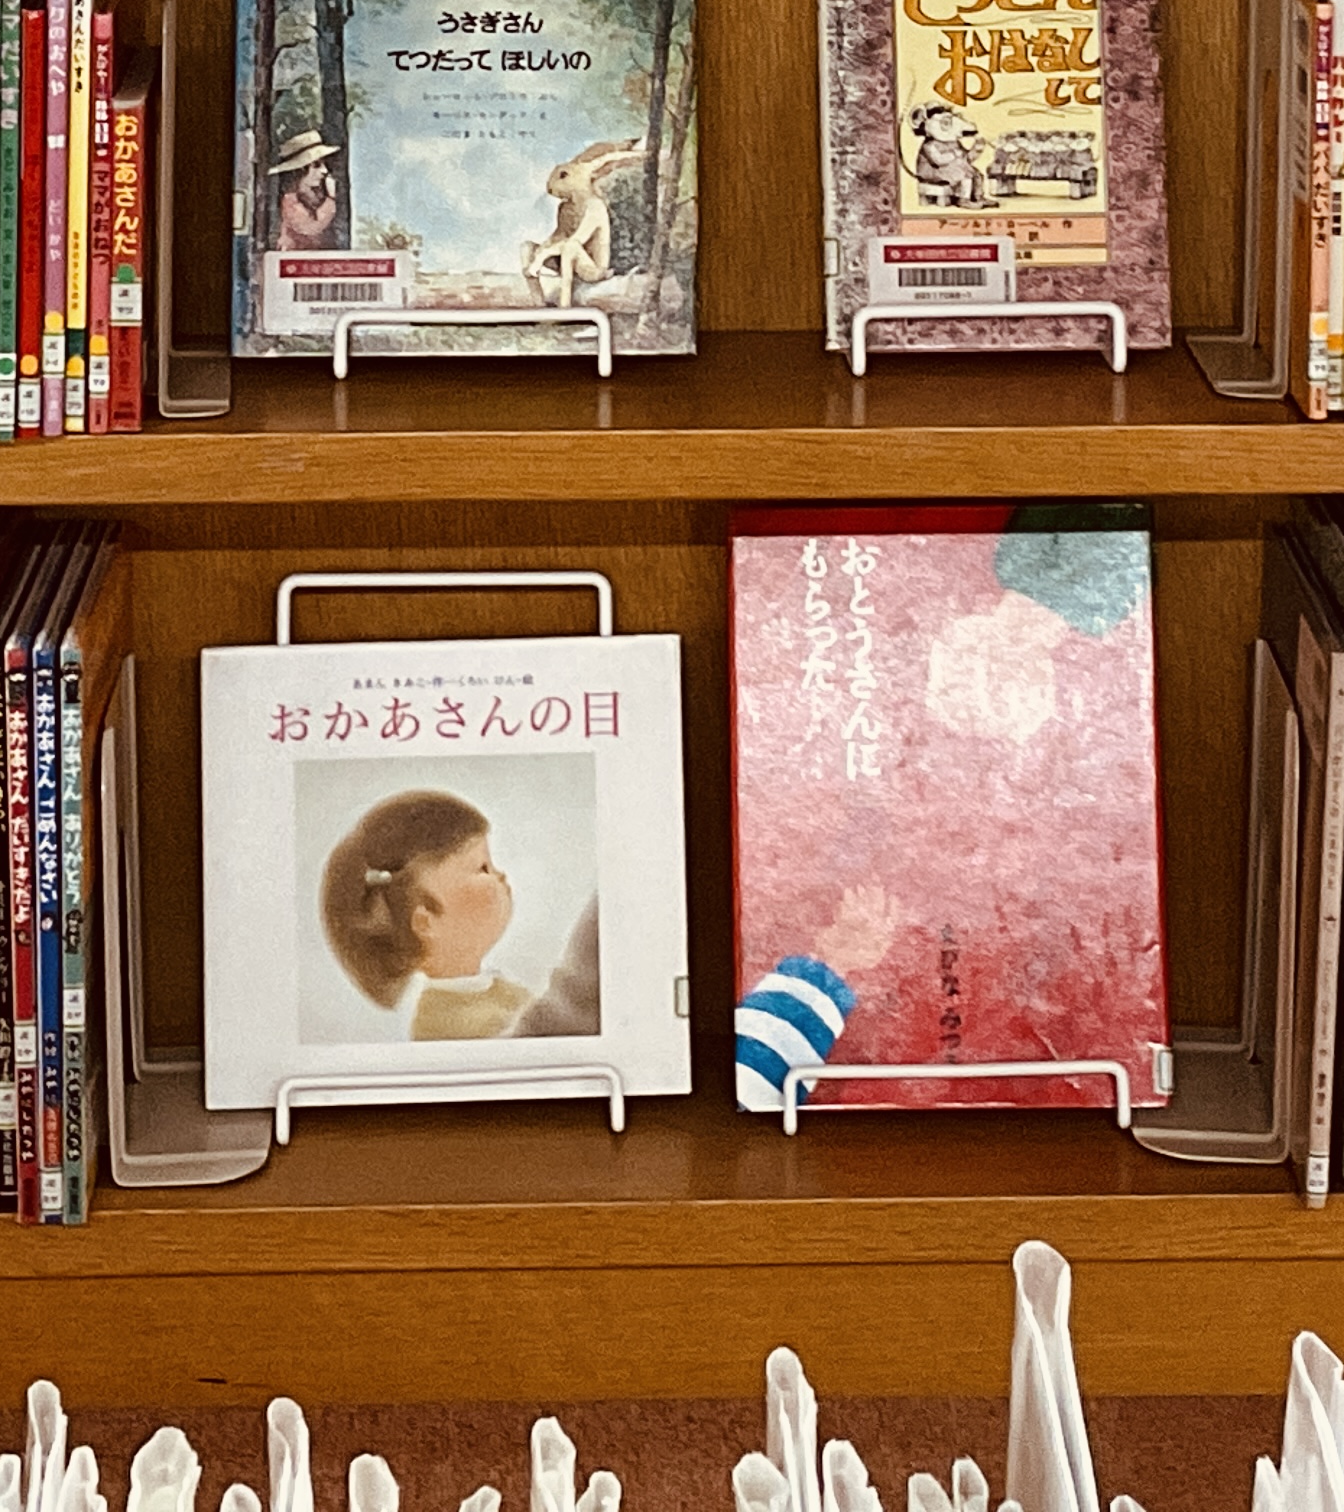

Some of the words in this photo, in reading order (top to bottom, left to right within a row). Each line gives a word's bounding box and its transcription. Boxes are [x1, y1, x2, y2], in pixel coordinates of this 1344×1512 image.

[386, 47, 495, 73] てつだって
[500, 47, 593, 73] ほしいの
[436, 9, 545, 35] うさぎさん
[932, 27, 1103, 107] おはなし
[1043, 75, 1103, 106] して
[112, 113, 141, 256] おかあさんだ
[840, 537, 883, 783] おとうさんに
[7, 709, 29, 805] おかあさん
[35, 692, 56, 789] おかあさん
[62, 707, 82, 801] おかあさん
[268, 689, 621, 743] おかあさんの目
[9, 814, 33, 925] だいすきだよ
[37, 799, 59, 904] ごめんなさい
[62, 812, 84, 905] ありがとう
